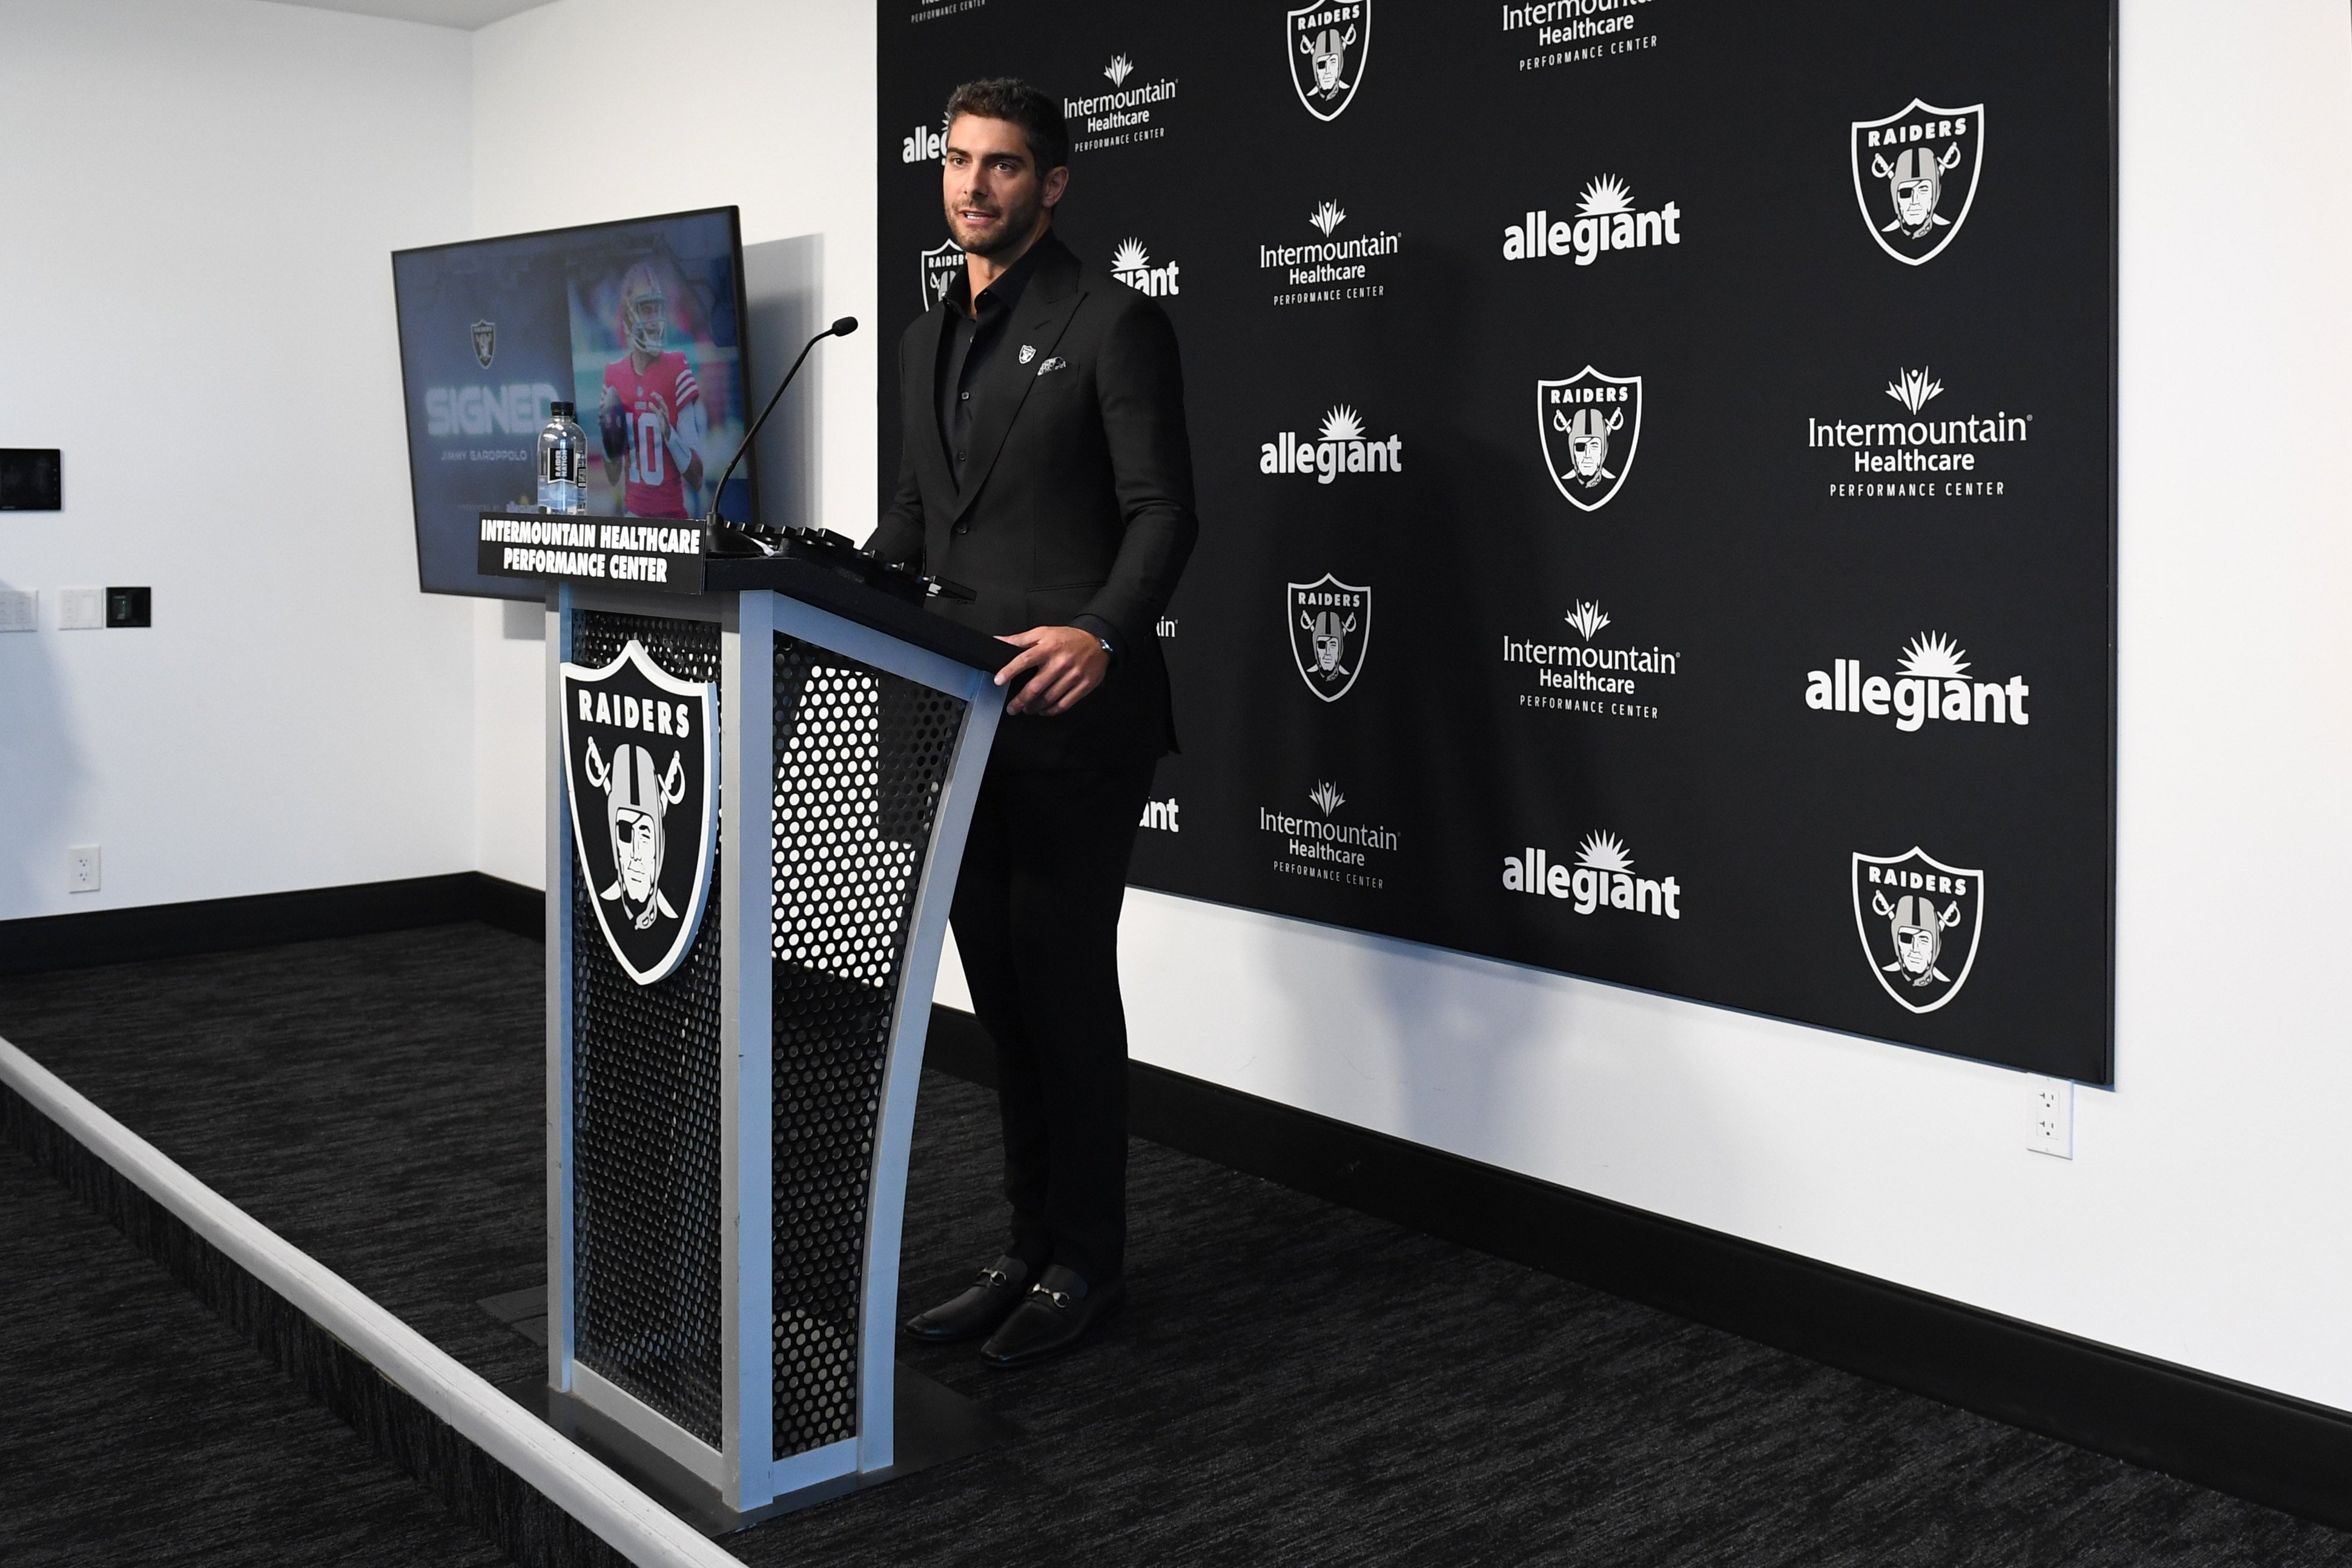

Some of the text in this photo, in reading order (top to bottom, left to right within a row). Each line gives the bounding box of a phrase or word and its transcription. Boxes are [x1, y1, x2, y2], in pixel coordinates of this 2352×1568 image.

[911, 4, 957, 23] PERFORMANCE
[1298, 4, 1360, 31] RAIDERS
[1539, 15, 1634, 47] Healthcare
[1519, 35, 1657, 71] PERFORMANCE CENTER
[1064, 78, 1176, 119] Intermountain
[1088, 110, 1150, 133] Healthcare
[1868, 117, 1966, 148] RAIDERS
[1075, 127, 1164, 153] PERFORMANCE CENTER
[1502, 200, 1680, 266] allegiant
[928, 254, 968, 268] RAIDER
[1260, 231, 1398, 268] Intermountain
[1289, 263, 1366, 285] Healthcare
[1273, 285, 1384, 306] PERFORMANCE CENTER
[426, 383, 560, 436] SIGNED
[1551, 386, 1628, 404] RAIDERS
[1808, 411, 2027, 447] Intermountain
[625, 412, 664, 486] 10
[1260, 431, 1402, 484] allegiant
[1855, 448, 1975, 472] Healthcare
[1830, 481, 2004, 497] PERFORMANCE CENTER
[481, 519, 701, 555] INTERMOUNTAIN HEALTHCARE
[503, 547, 667, 583] PERFORMANCE CENTER
[1298, 591, 1360, 607] RAIDERS
[1504, 635, 1676, 674] Intermountain
[1540, 668, 1635, 694] Healthcare
[1805, 658, 2029, 732] allegiant
[578, 689, 690, 738] RAIDERS
[1520, 694, 1657, 719] PERFORMANCE CENTER
[1260, 806, 1397, 851] Intermountain
[1289, 838, 1365, 866] Healthcare
[1273, 860, 1383, 889] PERFORMANCE CENTER
[1502, 847, 1680, 920] allegiant
[1869, 866, 1966, 896] RAIDERS
